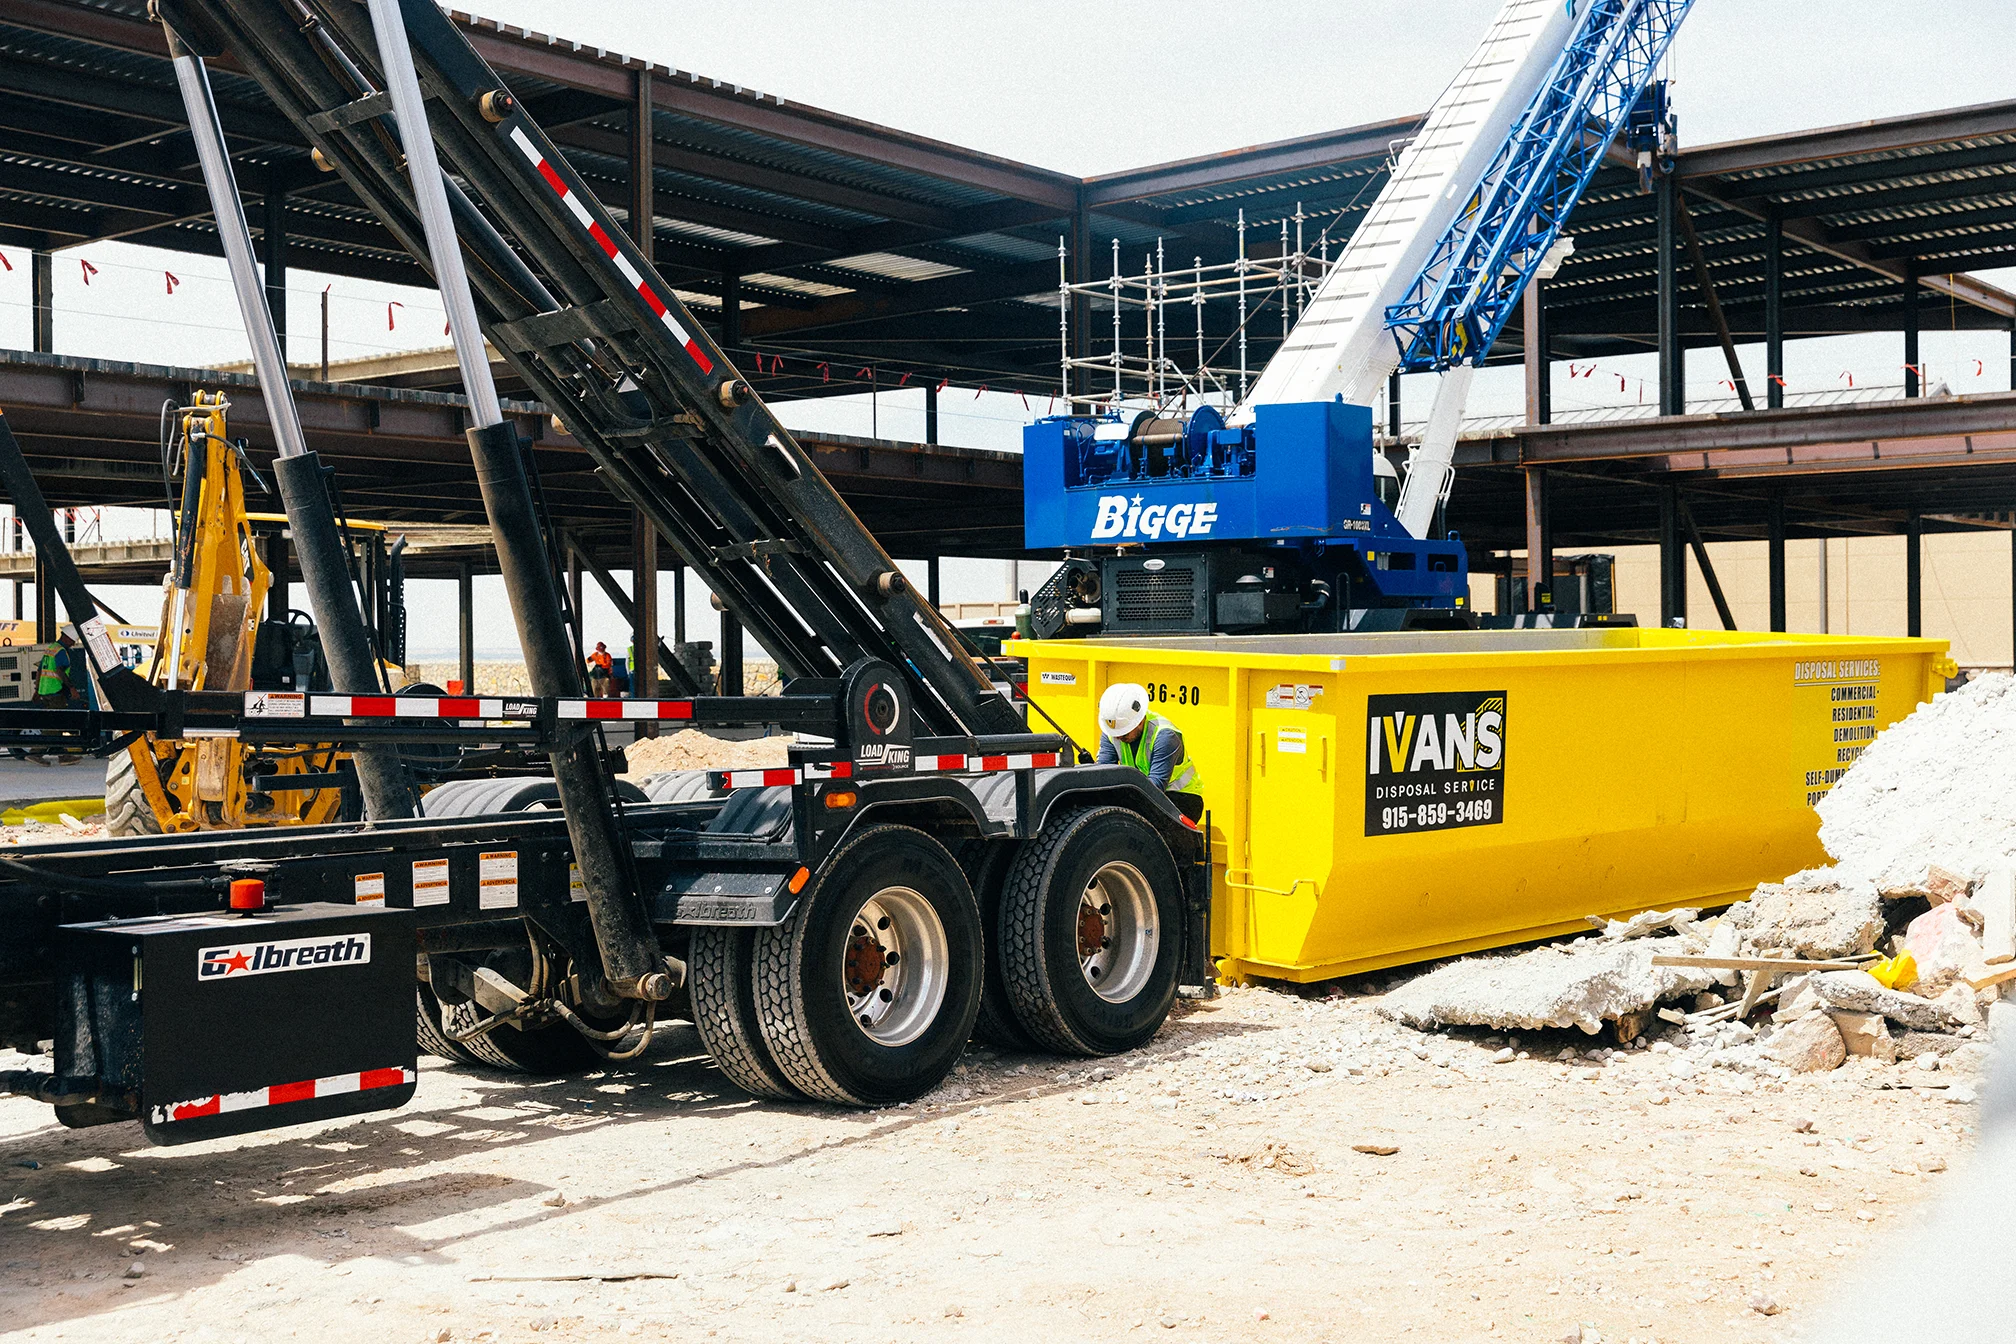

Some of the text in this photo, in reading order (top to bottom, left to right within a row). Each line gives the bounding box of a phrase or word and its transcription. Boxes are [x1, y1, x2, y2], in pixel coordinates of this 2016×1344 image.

[1794, 659, 1880, 680] DISPOSAL SERVICES:
[1147, 682, 1200, 706] 36-30
[1831, 686, 1876, 702] COMMERCIAL
[505, 703, 537, 715] LOAD KING
[1832, 706, 1875, 722] RESIDENTIAL
[1369, 710, 1502, 775] IVANS
[1834, 725, 1875, 742] DEMOLITION
[861, 744, 910, 764] LOAD KING
[1376, 779, 1495, 800] DISPOSAL SERVICE
[1382, 799, 1493, 829] 915-859-3469
